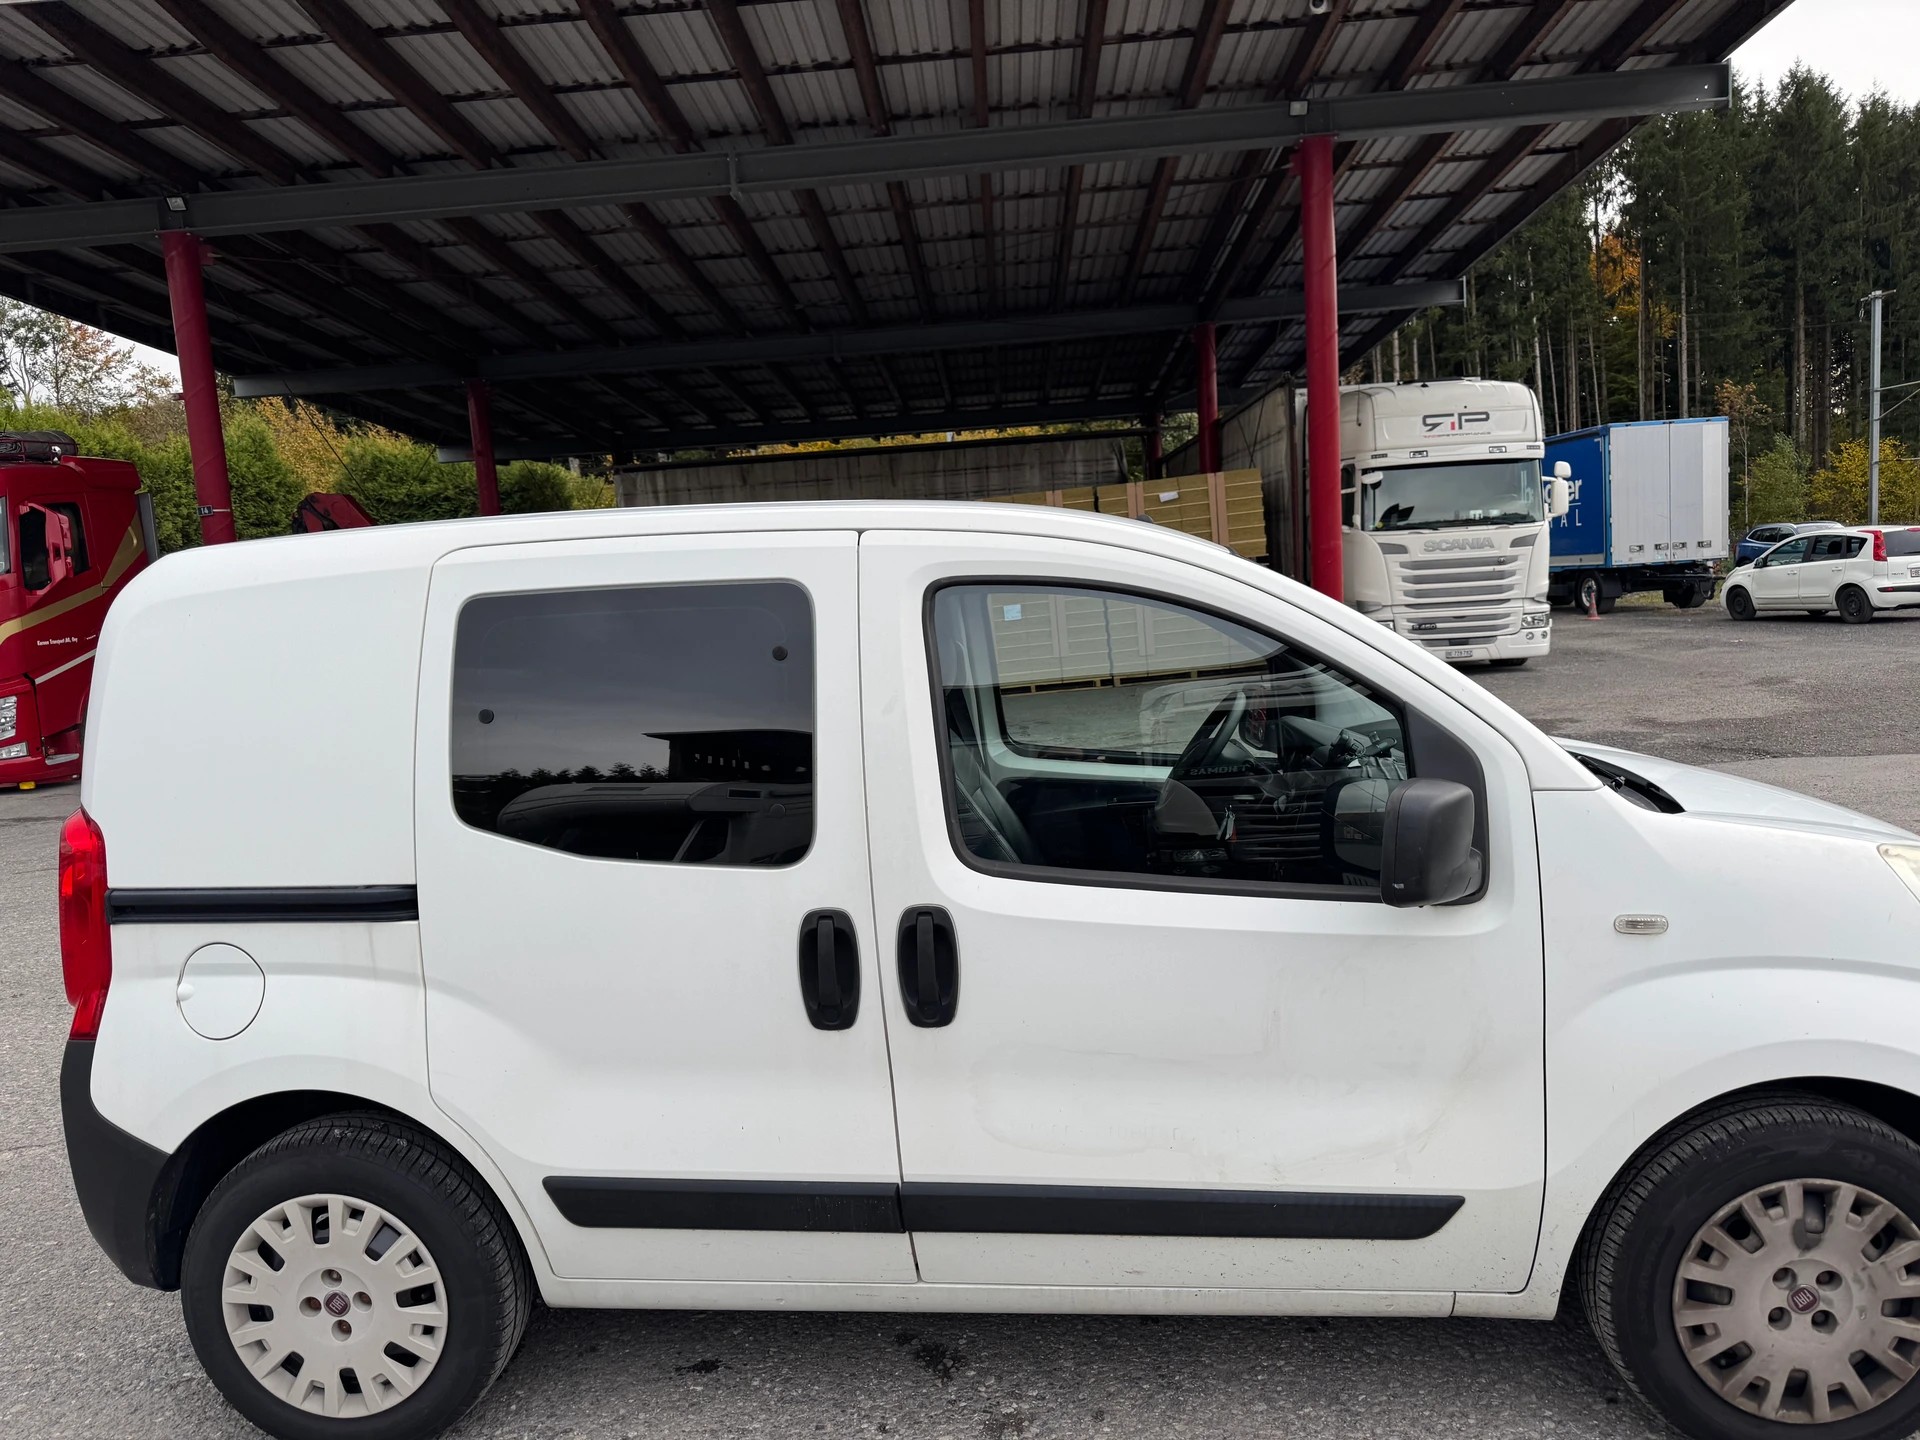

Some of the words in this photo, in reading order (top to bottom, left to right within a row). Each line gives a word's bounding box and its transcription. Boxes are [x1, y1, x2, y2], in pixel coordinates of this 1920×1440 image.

[1423, 537, 1495, 552] SCANIA
[329, 1295, 346, 1313] FIAT
[1793, 1289, 1813, 1308] FIAT
